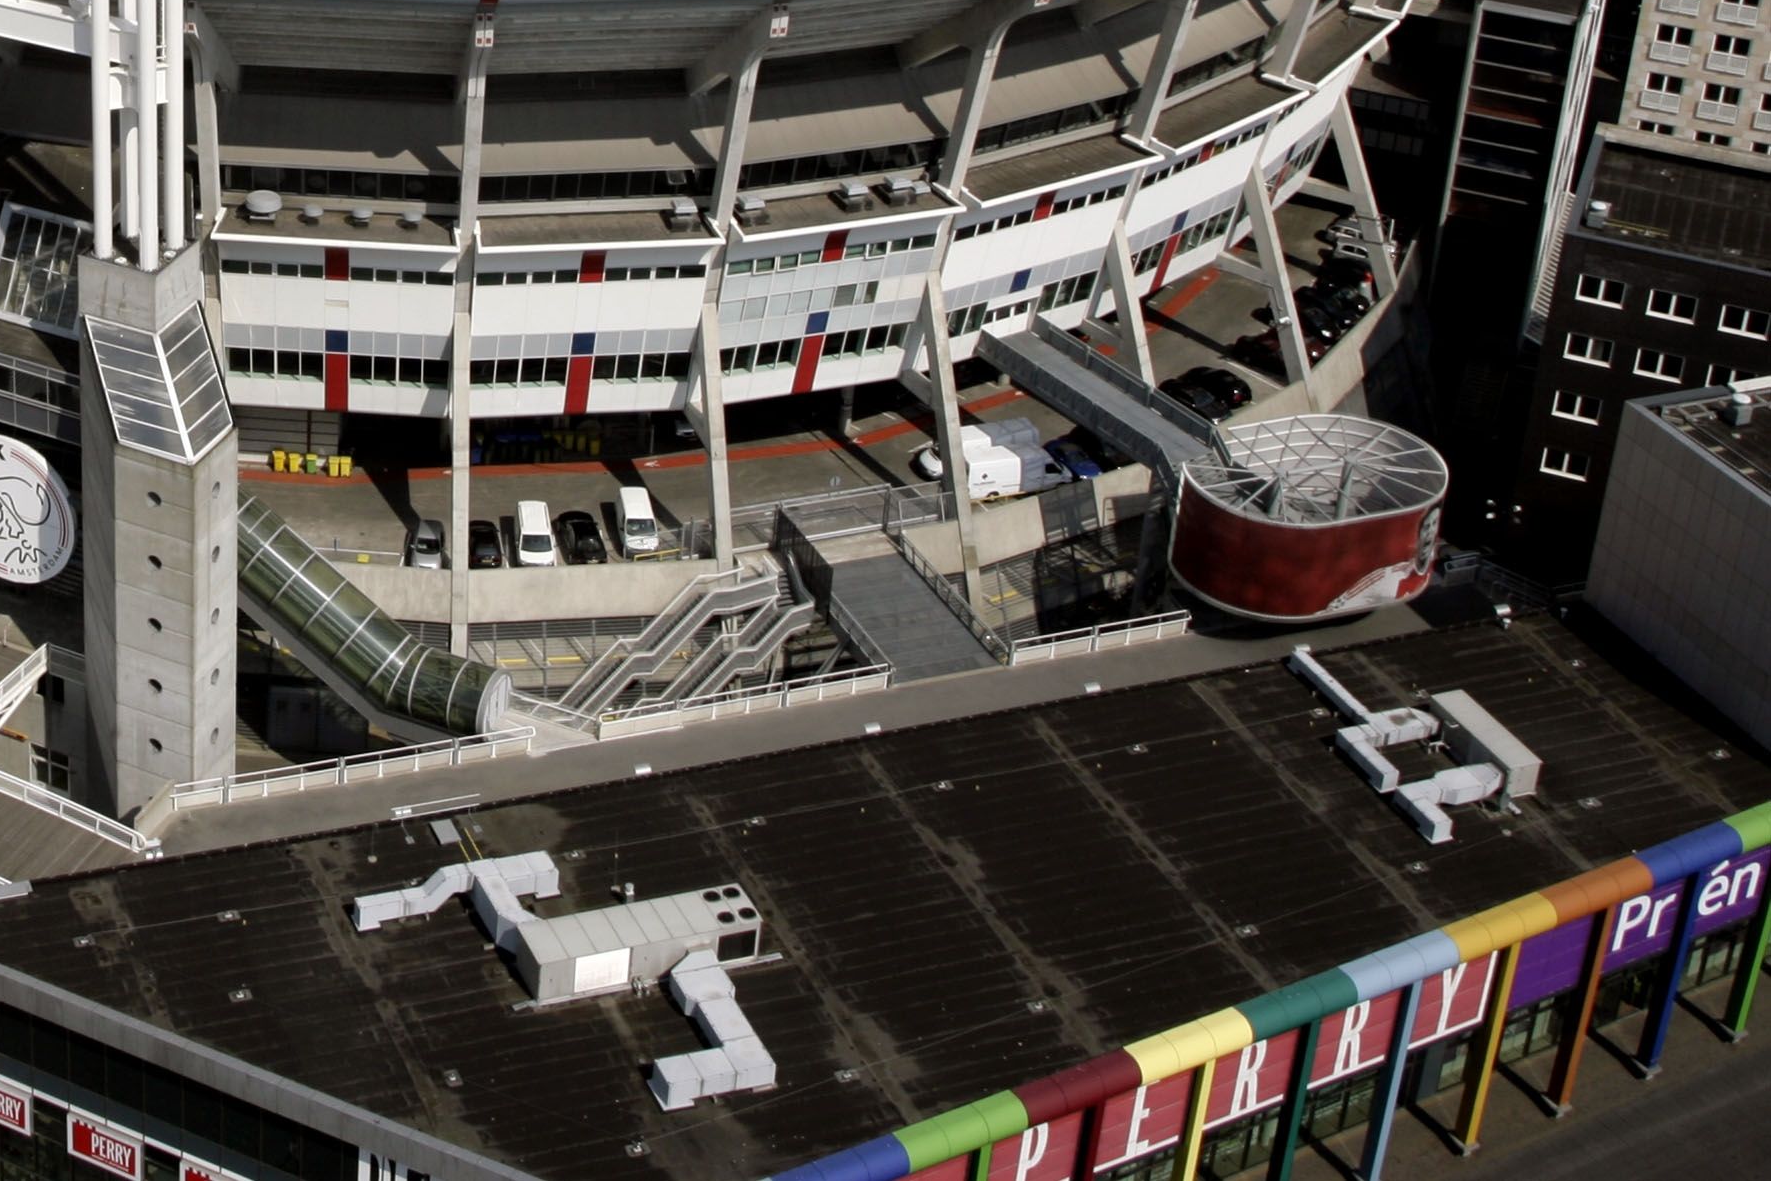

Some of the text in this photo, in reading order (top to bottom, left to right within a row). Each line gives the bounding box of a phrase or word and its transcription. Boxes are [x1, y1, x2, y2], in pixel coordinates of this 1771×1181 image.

[9, 547, 65, 577] AMSTERDAM
[1016, 961, 1468, 1181] PERRY
[91, 1133, 132, 1167] PERRY
